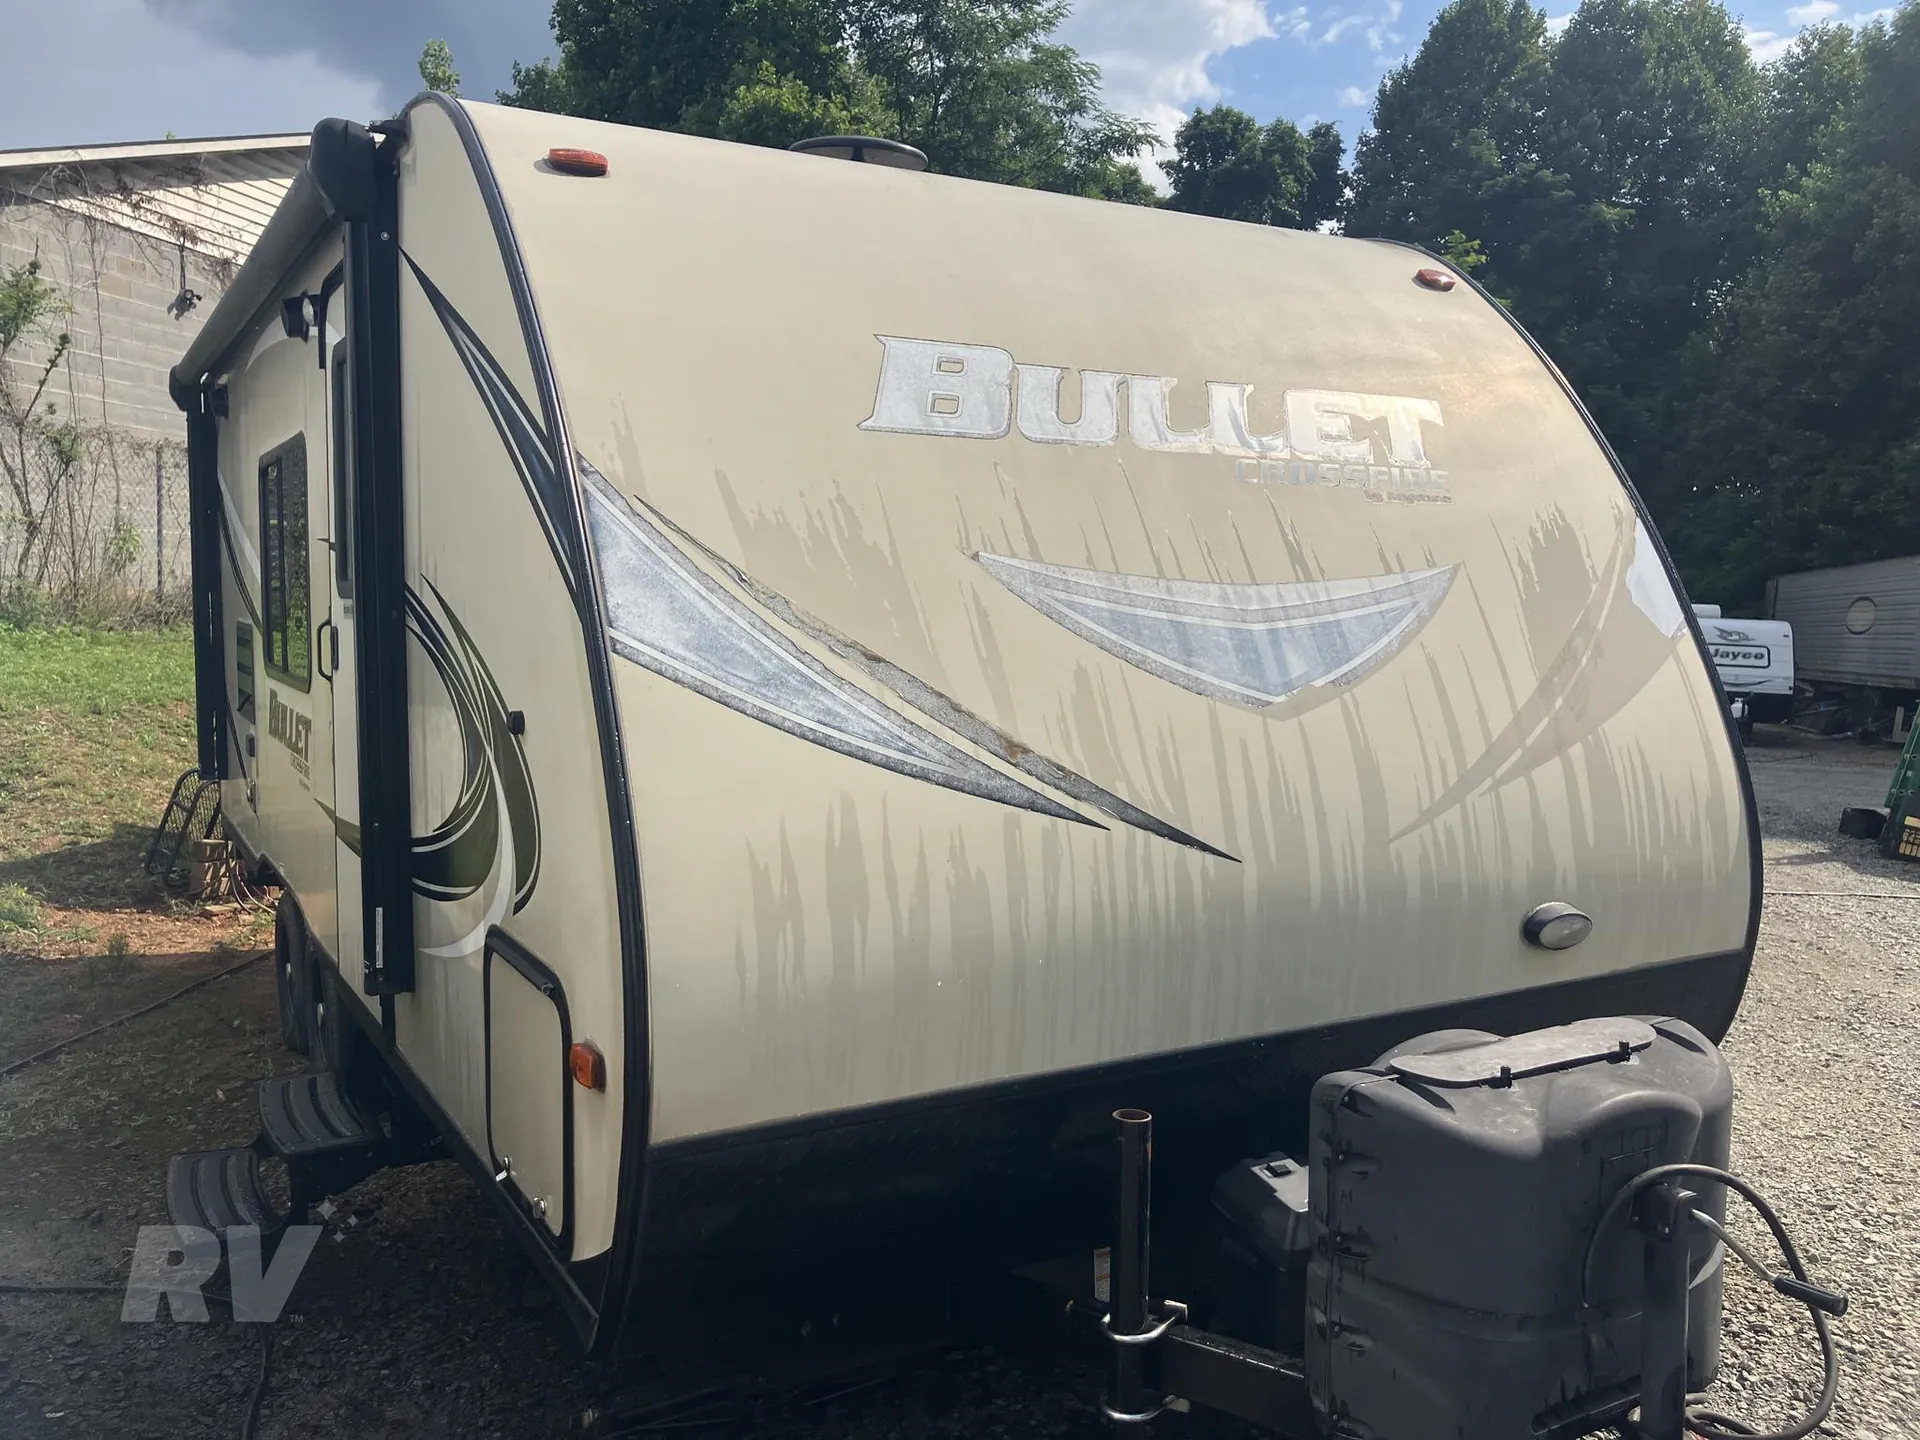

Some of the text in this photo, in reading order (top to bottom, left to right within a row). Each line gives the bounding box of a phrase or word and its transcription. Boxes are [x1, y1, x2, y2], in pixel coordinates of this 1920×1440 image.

[856, 333, 1446, 468] BULLET
[1235, 458, 1451, 493] CROSSFIRE
[1712, 648, 1766, 661] Jayco
[268, 687, 312, 763] BULLET
